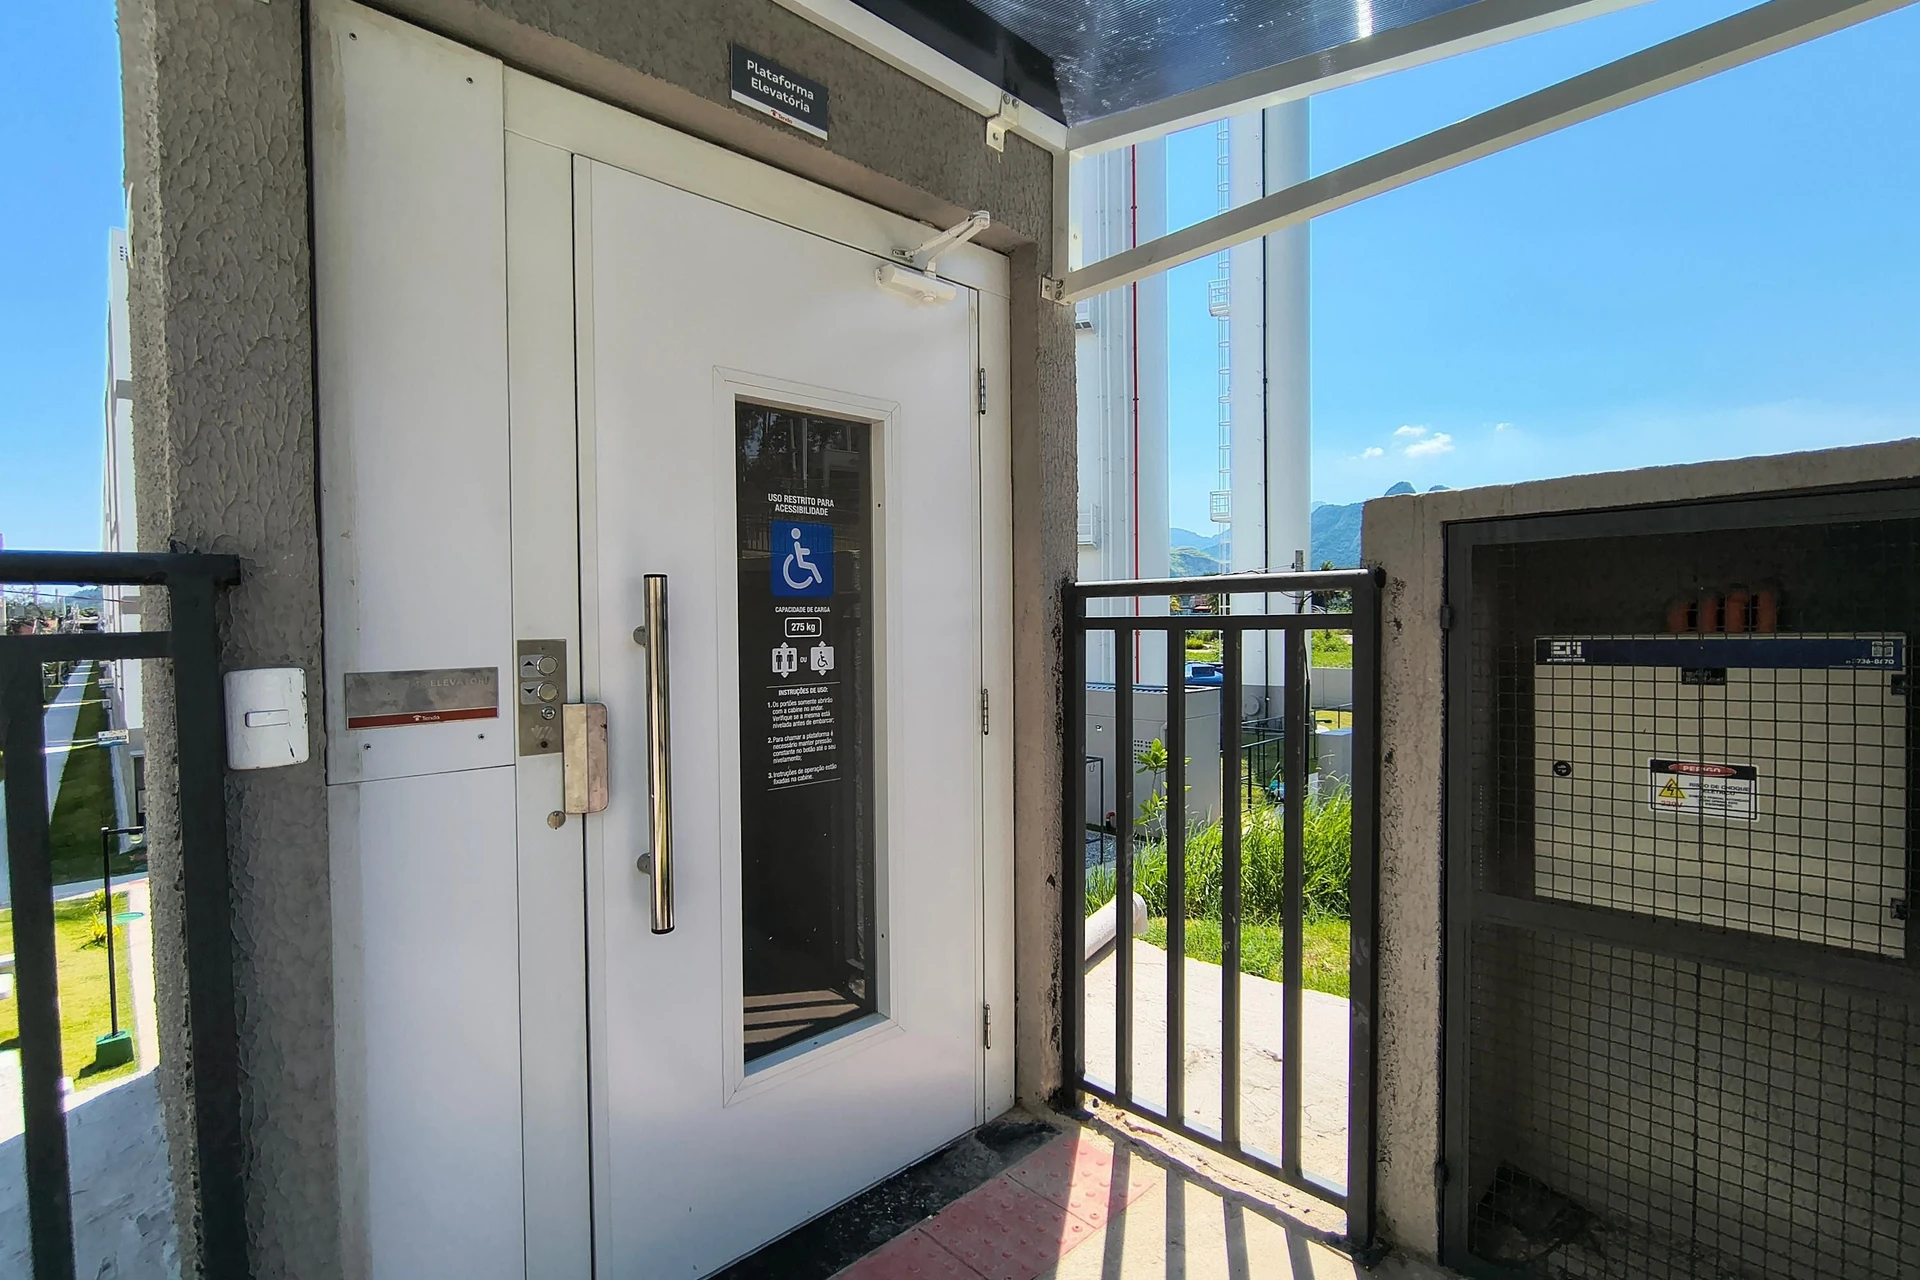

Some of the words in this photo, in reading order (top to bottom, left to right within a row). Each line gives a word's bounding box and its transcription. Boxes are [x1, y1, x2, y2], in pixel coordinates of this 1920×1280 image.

[747, 60, 814, 100] Plataforma
[751, 77, 810, 113] Elevatória
[768, 493, 782, 502] USO
[783, 495, 816, 506] RESTRITO
[817, 498, 835, 507] PARA
[775, 504, 829, 516] ACESSIBILIDADE
[791, 623, 805, 632] 275
[806, 622, 816, 633] kg
[779, 687, 809, 696] INSTRUÇÕES
